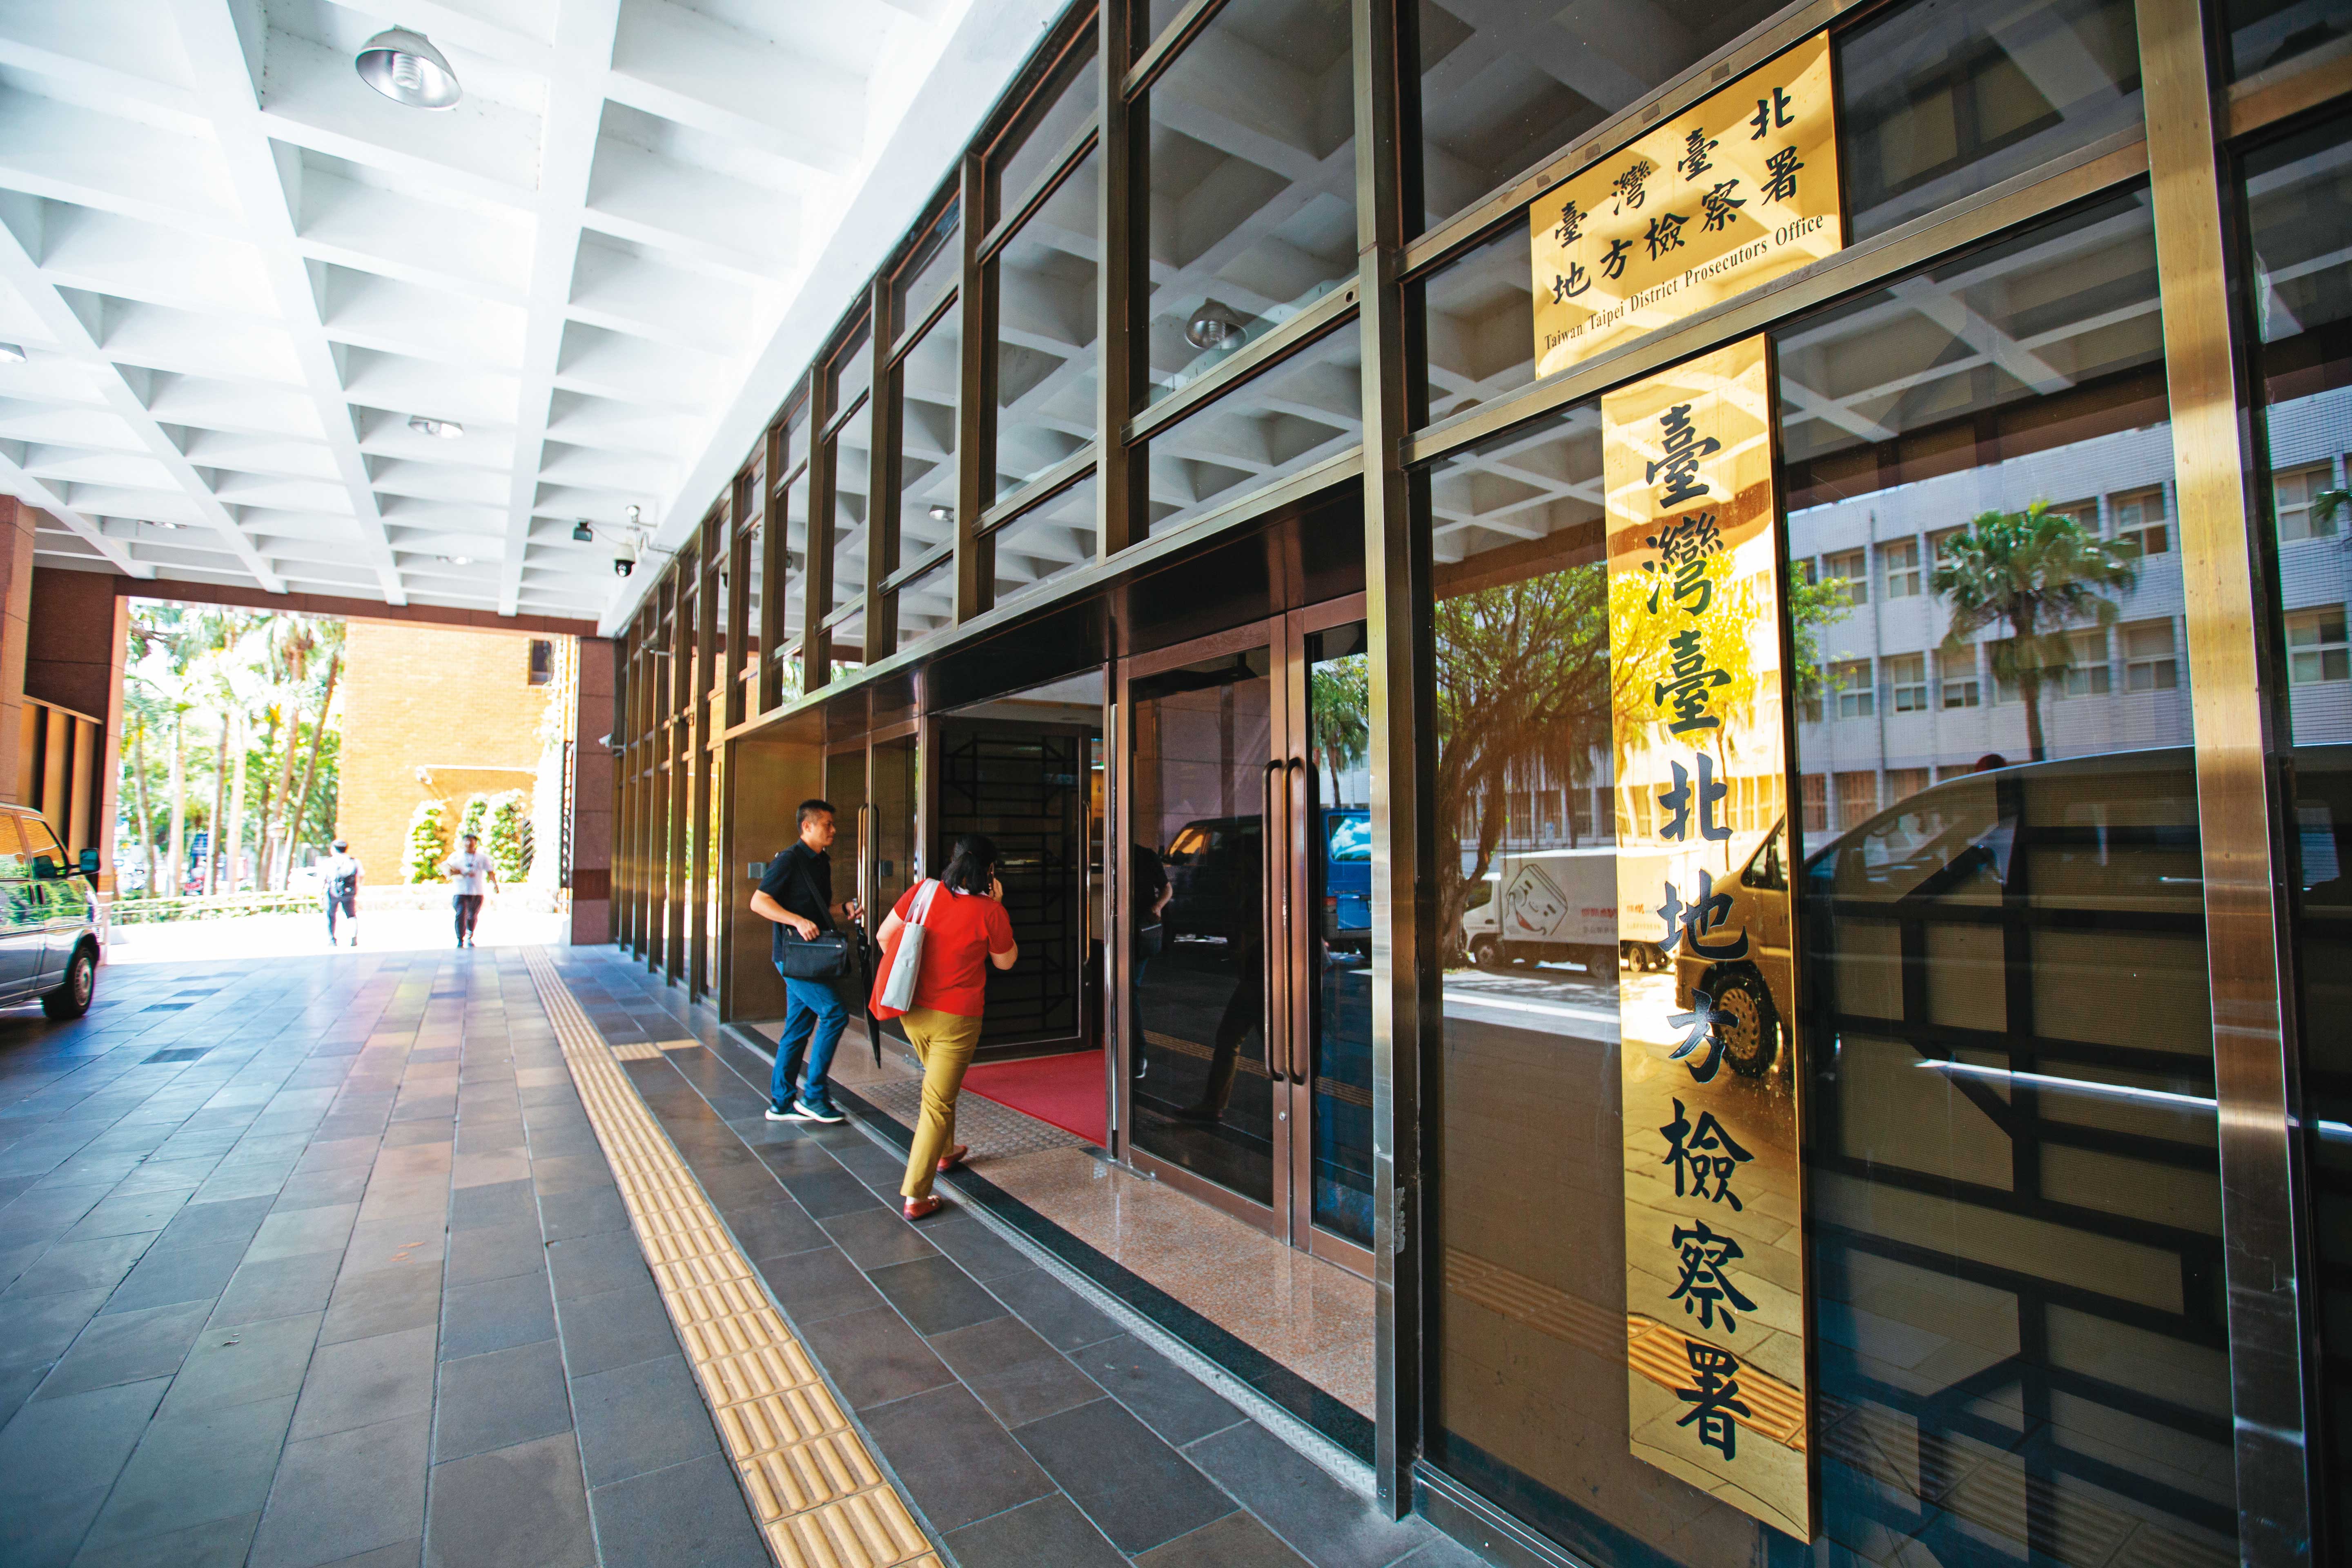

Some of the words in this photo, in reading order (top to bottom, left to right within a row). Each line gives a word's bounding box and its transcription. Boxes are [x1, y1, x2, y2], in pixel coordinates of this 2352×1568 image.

[1553, 146, 1804, 305] 地方檢察署
[1555, 87, 1795, 248] 臺灣臺北
[1545, 325, 1583, 350] Taiwan
[1588, 303, 1624, 330] Taipei
[1630, 281, 1677, 312] District
[1685, 242, 1767, 287] Prosecutors
[1775, 215, 1823, 246] Office
[1643, 404, 1757, 1461] 臺灣臺北地方檢察署
